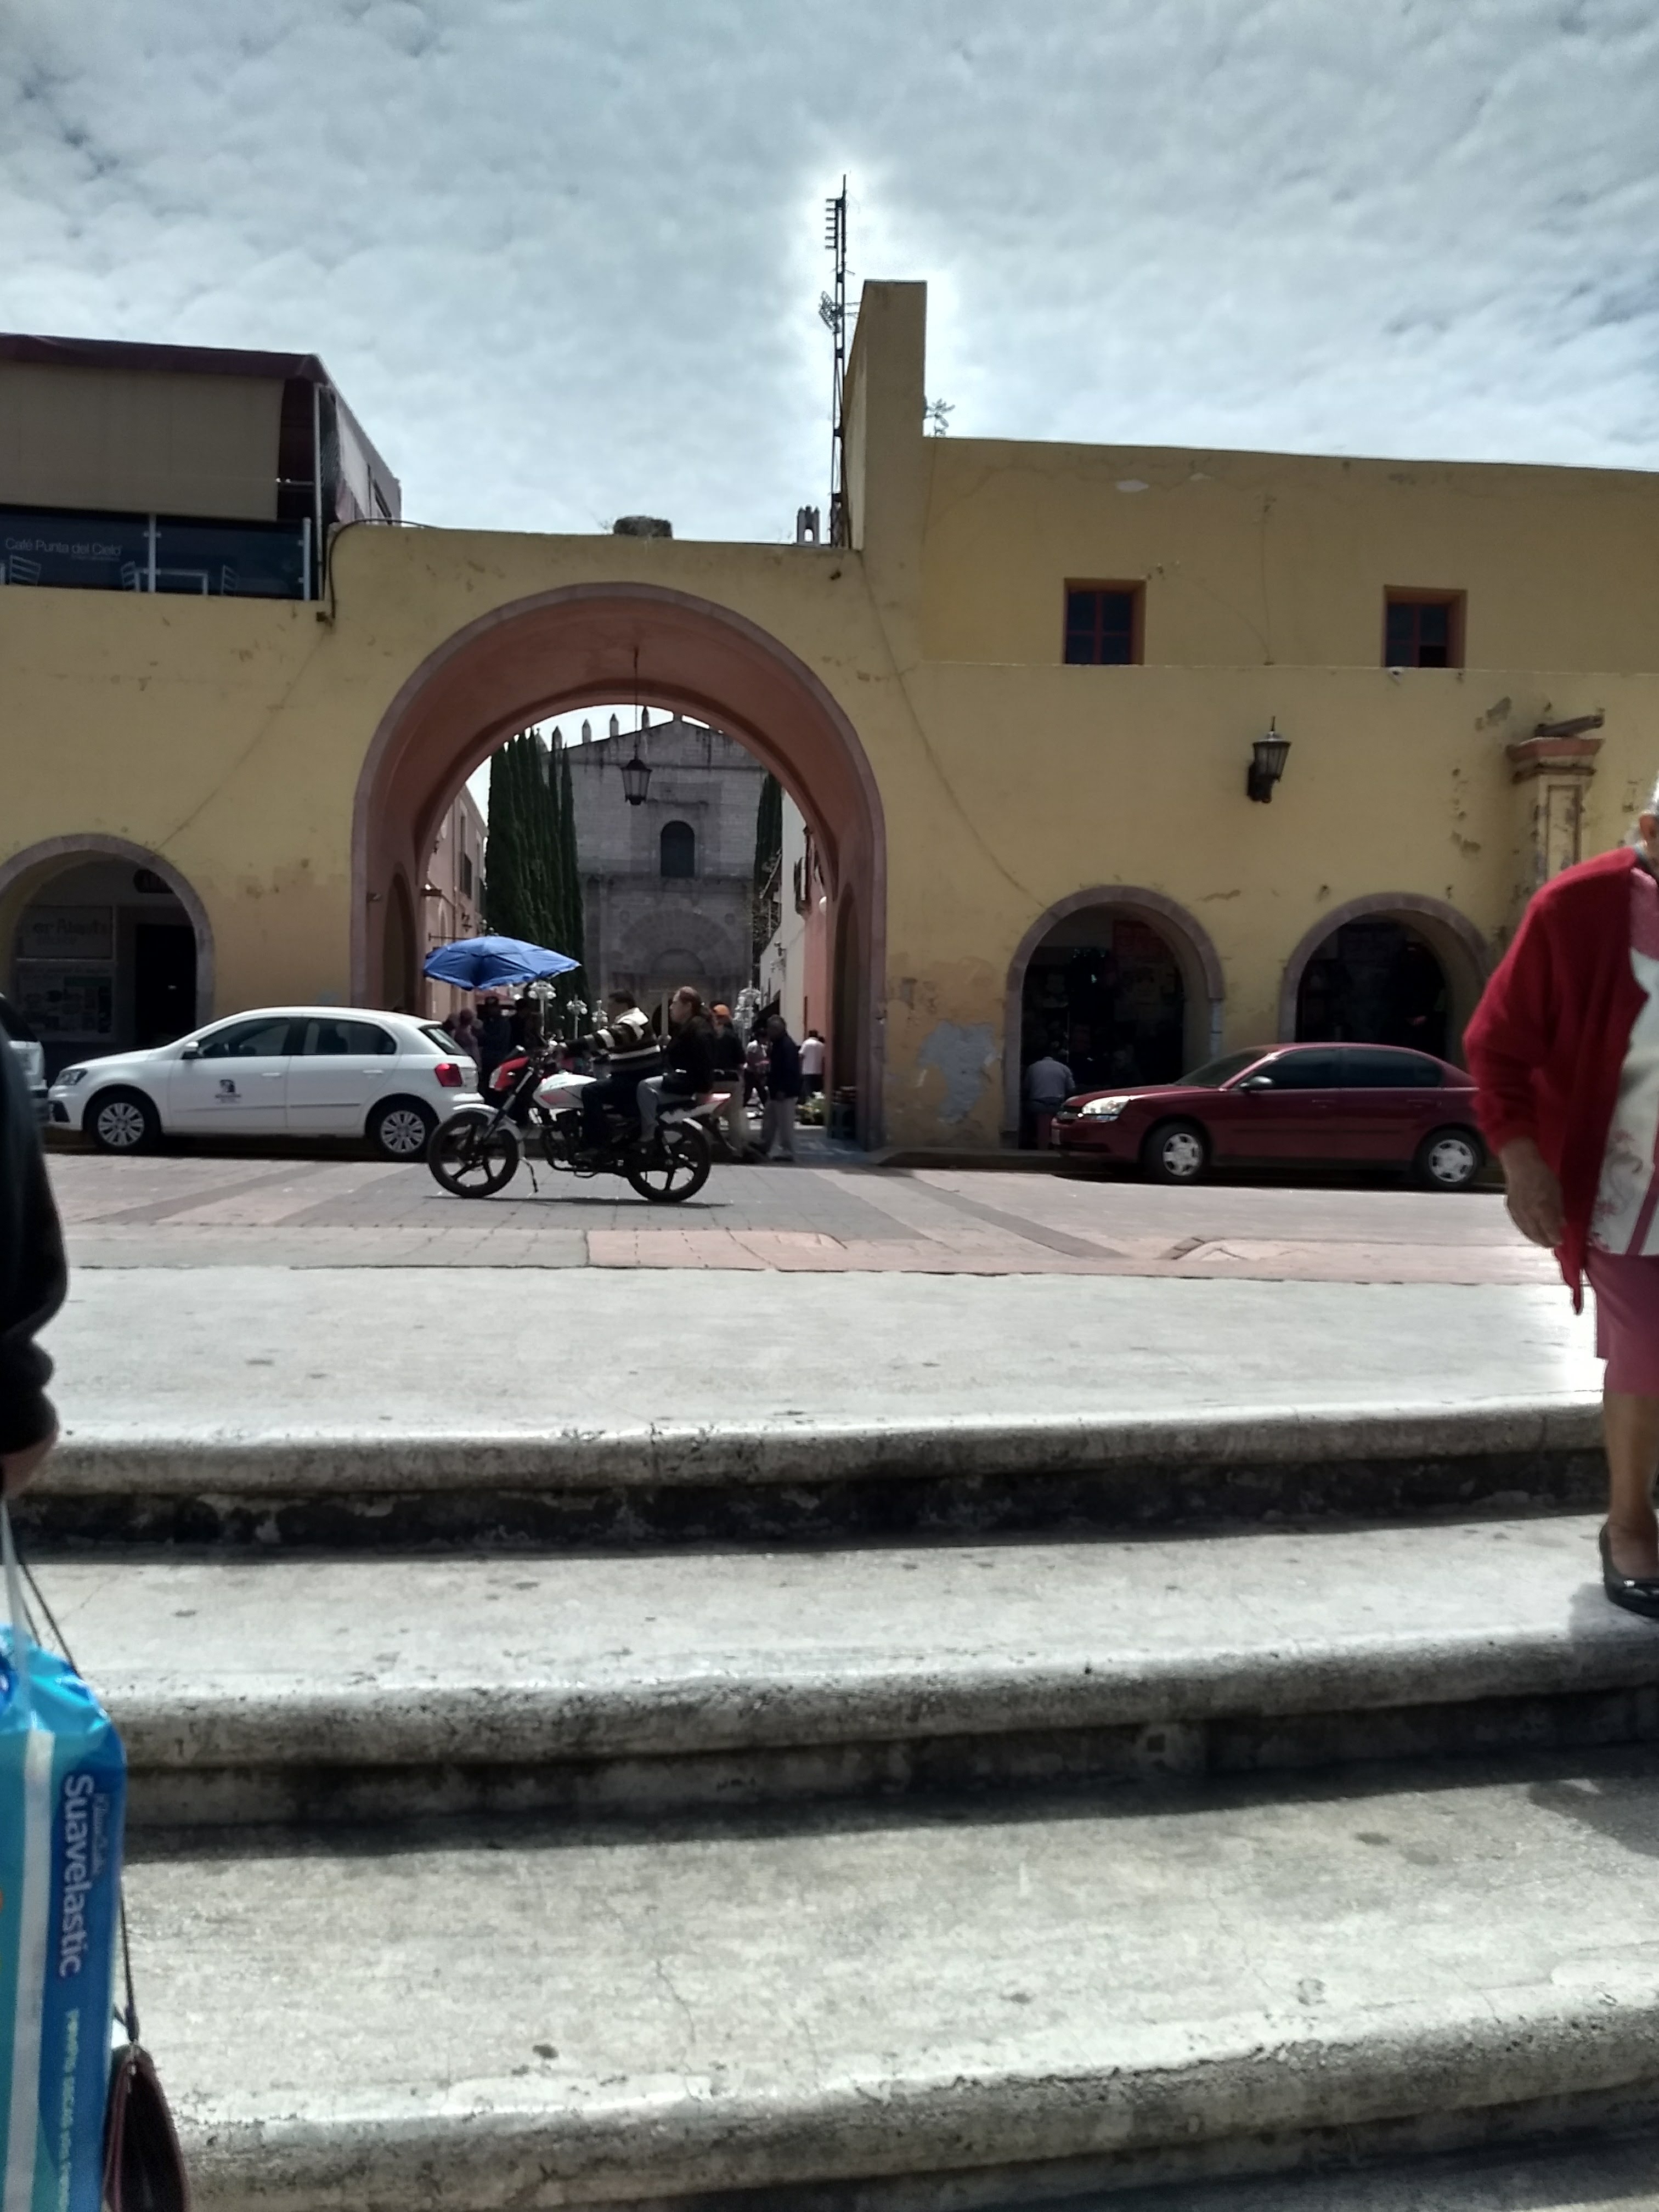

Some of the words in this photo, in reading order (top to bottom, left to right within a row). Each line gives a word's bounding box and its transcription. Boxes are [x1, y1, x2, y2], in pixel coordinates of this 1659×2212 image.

[5, 537, 33, 551] Café
[36, 540, 69, 554] Punta
[72, 542, 89, 555] del
[58, 1774, 95, 1979] Suavelastic
